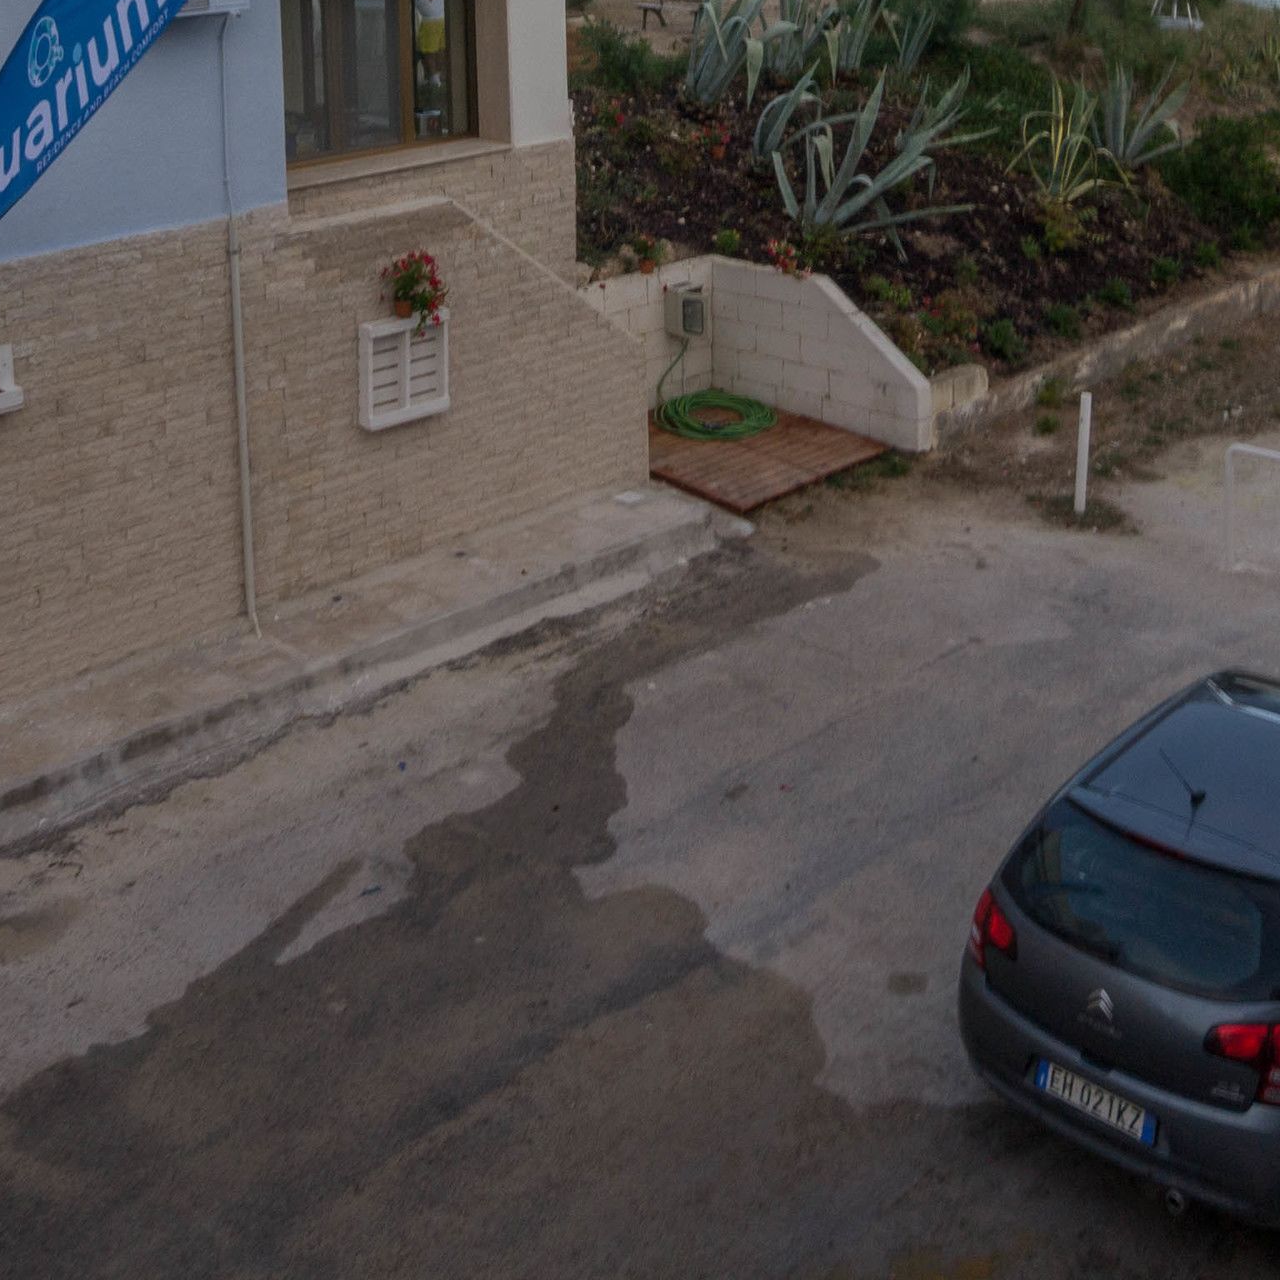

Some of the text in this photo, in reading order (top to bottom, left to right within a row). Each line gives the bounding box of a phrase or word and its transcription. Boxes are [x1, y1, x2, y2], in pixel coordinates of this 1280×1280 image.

[36, 6, 169, 174] RESIDENCE AND BEACH COMFORT
